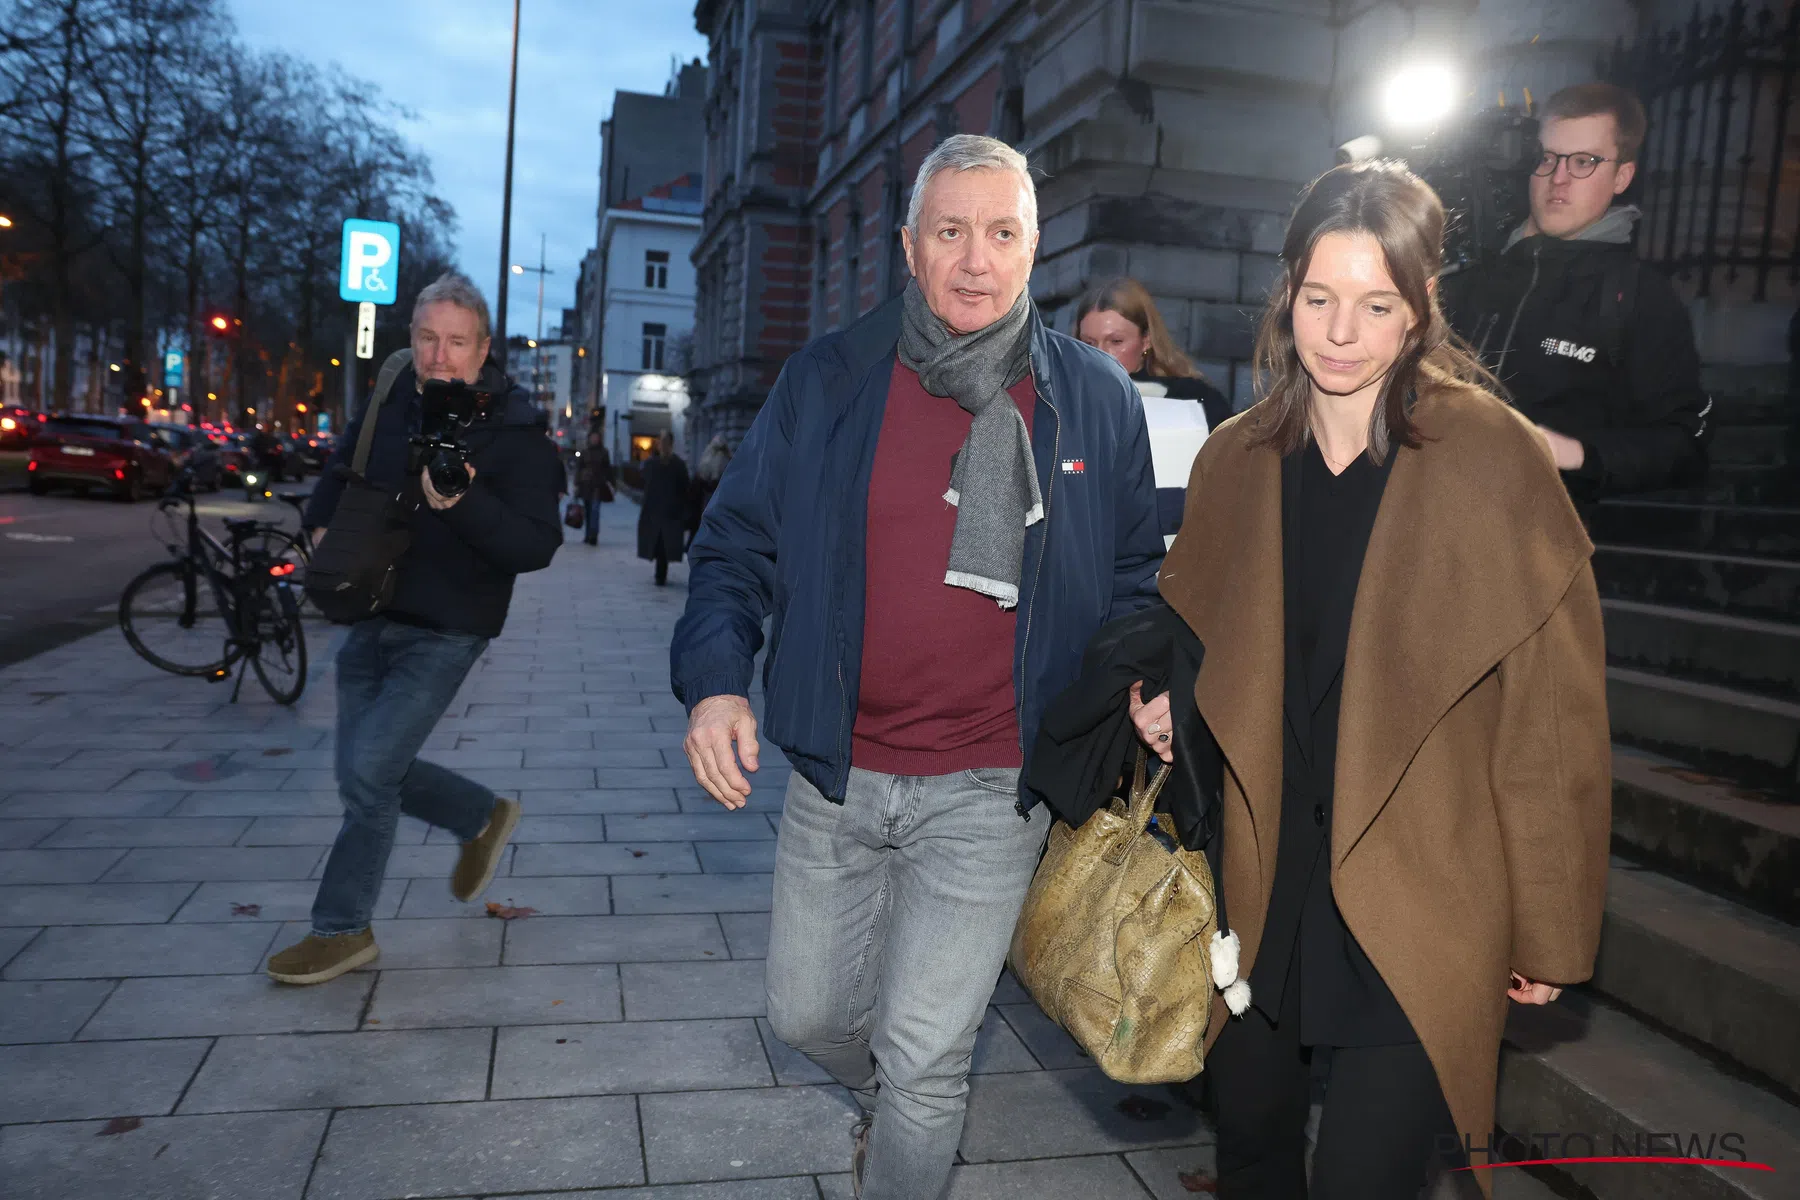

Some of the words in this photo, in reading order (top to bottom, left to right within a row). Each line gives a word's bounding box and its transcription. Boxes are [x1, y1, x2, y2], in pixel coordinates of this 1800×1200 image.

[348, 231, 391, 290] P
[166, 353, 181, 370] P
[1557, 340, 1596, 363] EMG
